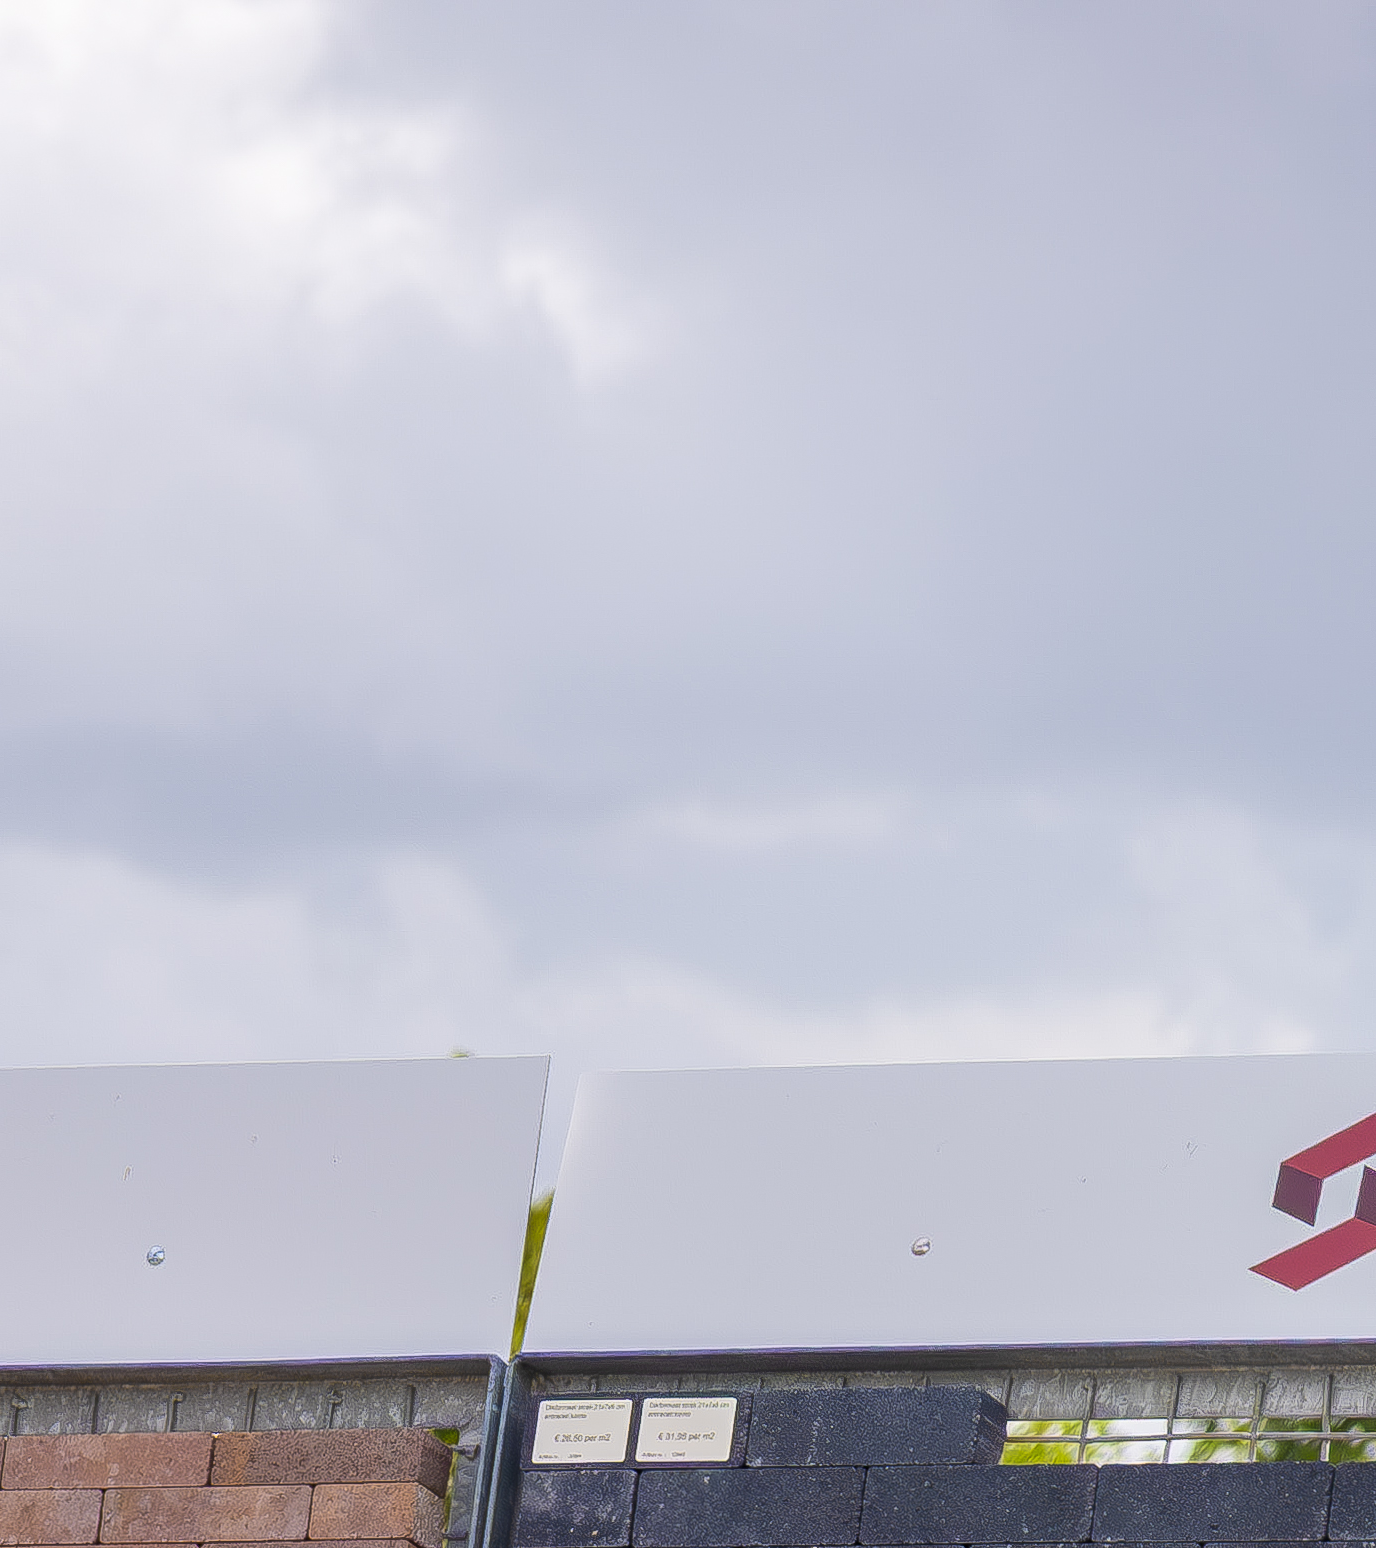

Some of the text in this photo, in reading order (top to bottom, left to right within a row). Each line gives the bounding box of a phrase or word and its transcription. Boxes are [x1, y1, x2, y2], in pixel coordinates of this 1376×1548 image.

[584, 1435, 597, 1443] per
[598, 1433, 611, 1441] m2
[688, 1433, 701, 1441] per
[702, 1432, 716, 1440] m2
